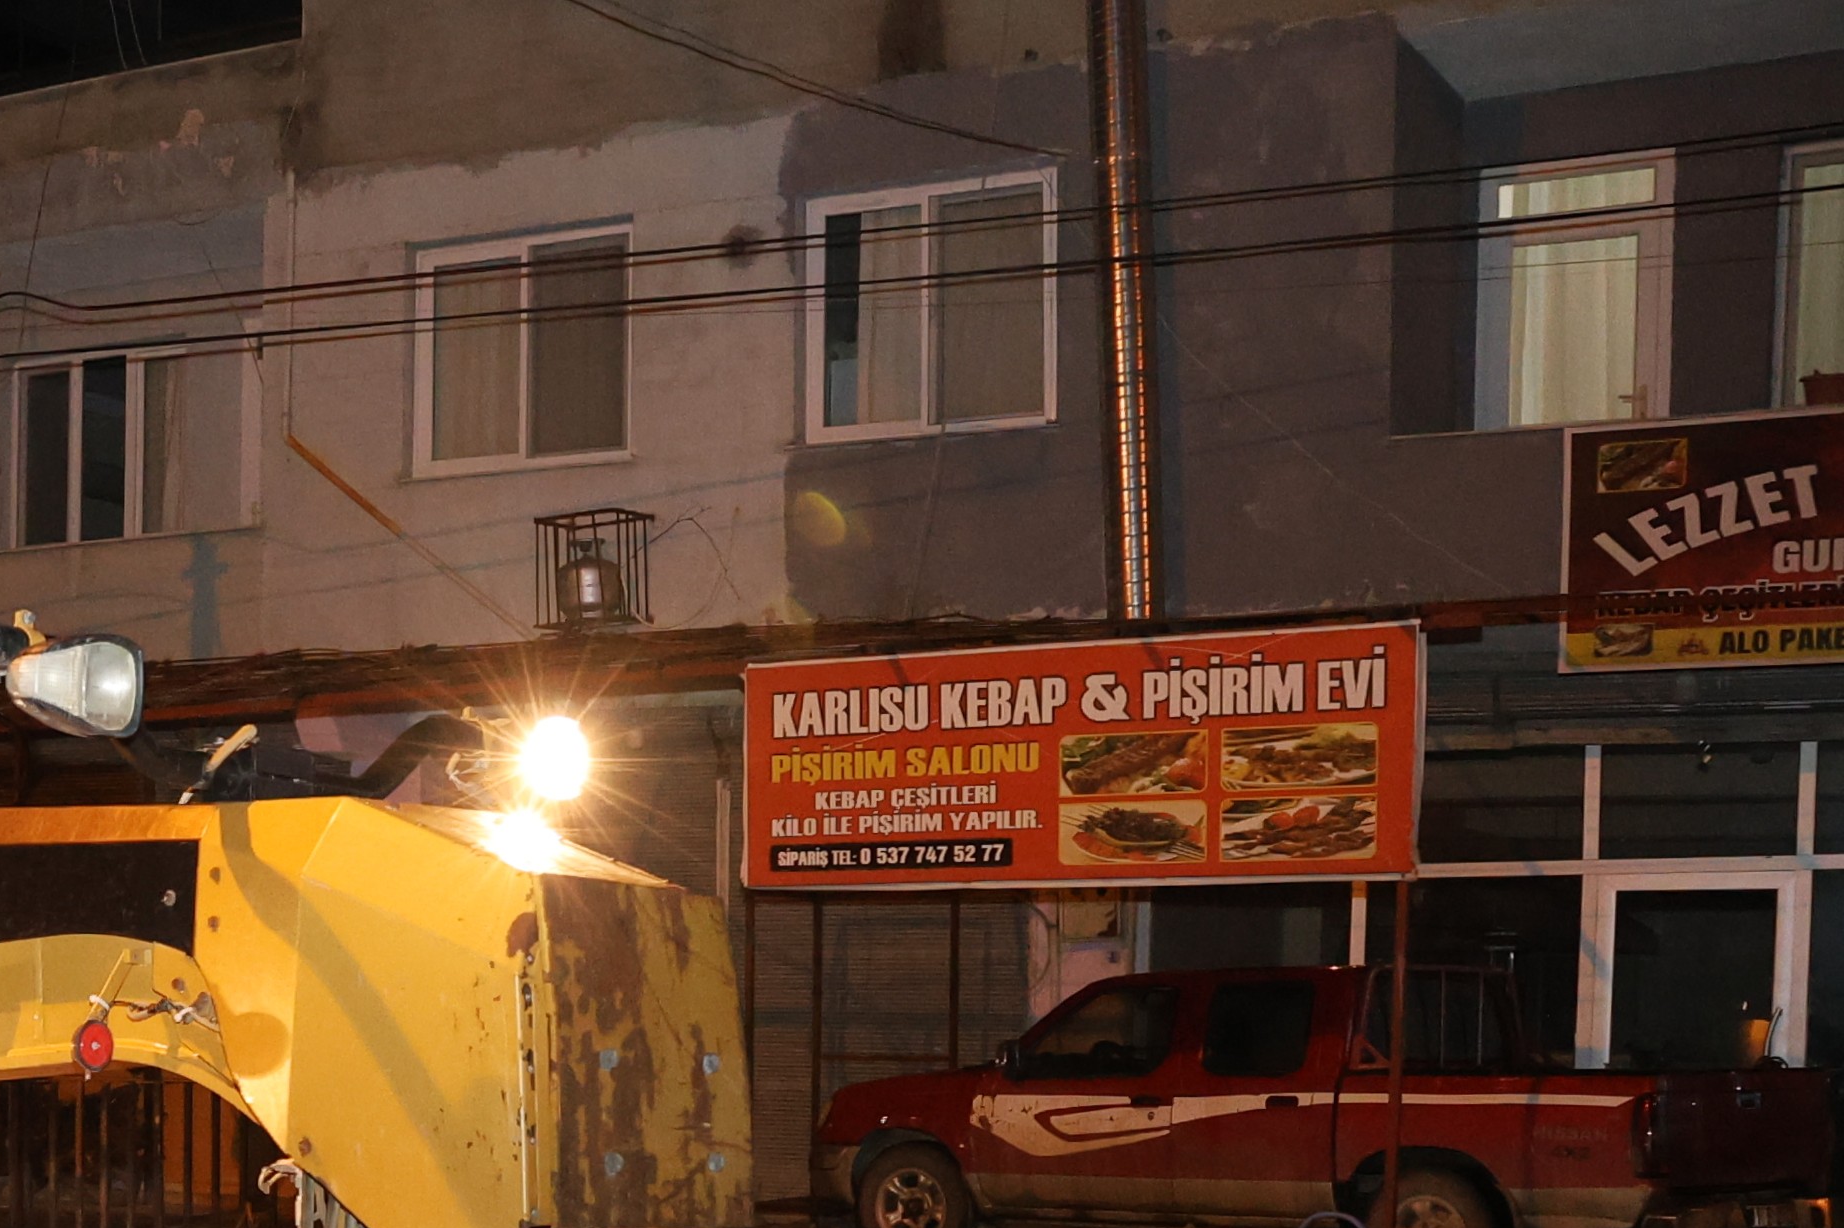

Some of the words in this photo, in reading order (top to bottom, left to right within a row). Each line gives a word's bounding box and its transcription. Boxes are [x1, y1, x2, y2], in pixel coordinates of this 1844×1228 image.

[1593, 465, 1818, 577] LEZZET
[1719, 631, 1769, 654] ALO
[772, 684, 930, 739] KARLISU
[940, 676, 1068, 731] KEBAP
[1080, 673, 1131, 723] &
[1141, 652, 1305, 725] PİŞİRİM
[1316, 644, 1387, 711] EVİ
[771, 744, 897, 786] PİŞİRİM
[906, 741, 1040, 778] SALONU
[814, 790, 885, 811] KEBAP
[890, 780, 998, 809] ÇEŞİTLERİ
[771, 814, 817, 837] KİLO
[823, 813, 853, 836] İLE
[858, 810, 943, 836] PİŞİRİM
[949, 809, 1044, 831] YAPILIR.
[777, 847, 829, 868] SİPARİŞ
[859, 847, 872, 865] 0
[876, 846, 909, 864] 537
[915, 845, 949, 863] 747
[952, 844, 977, 862] 52
[980, 843, 1005, 861] 77
